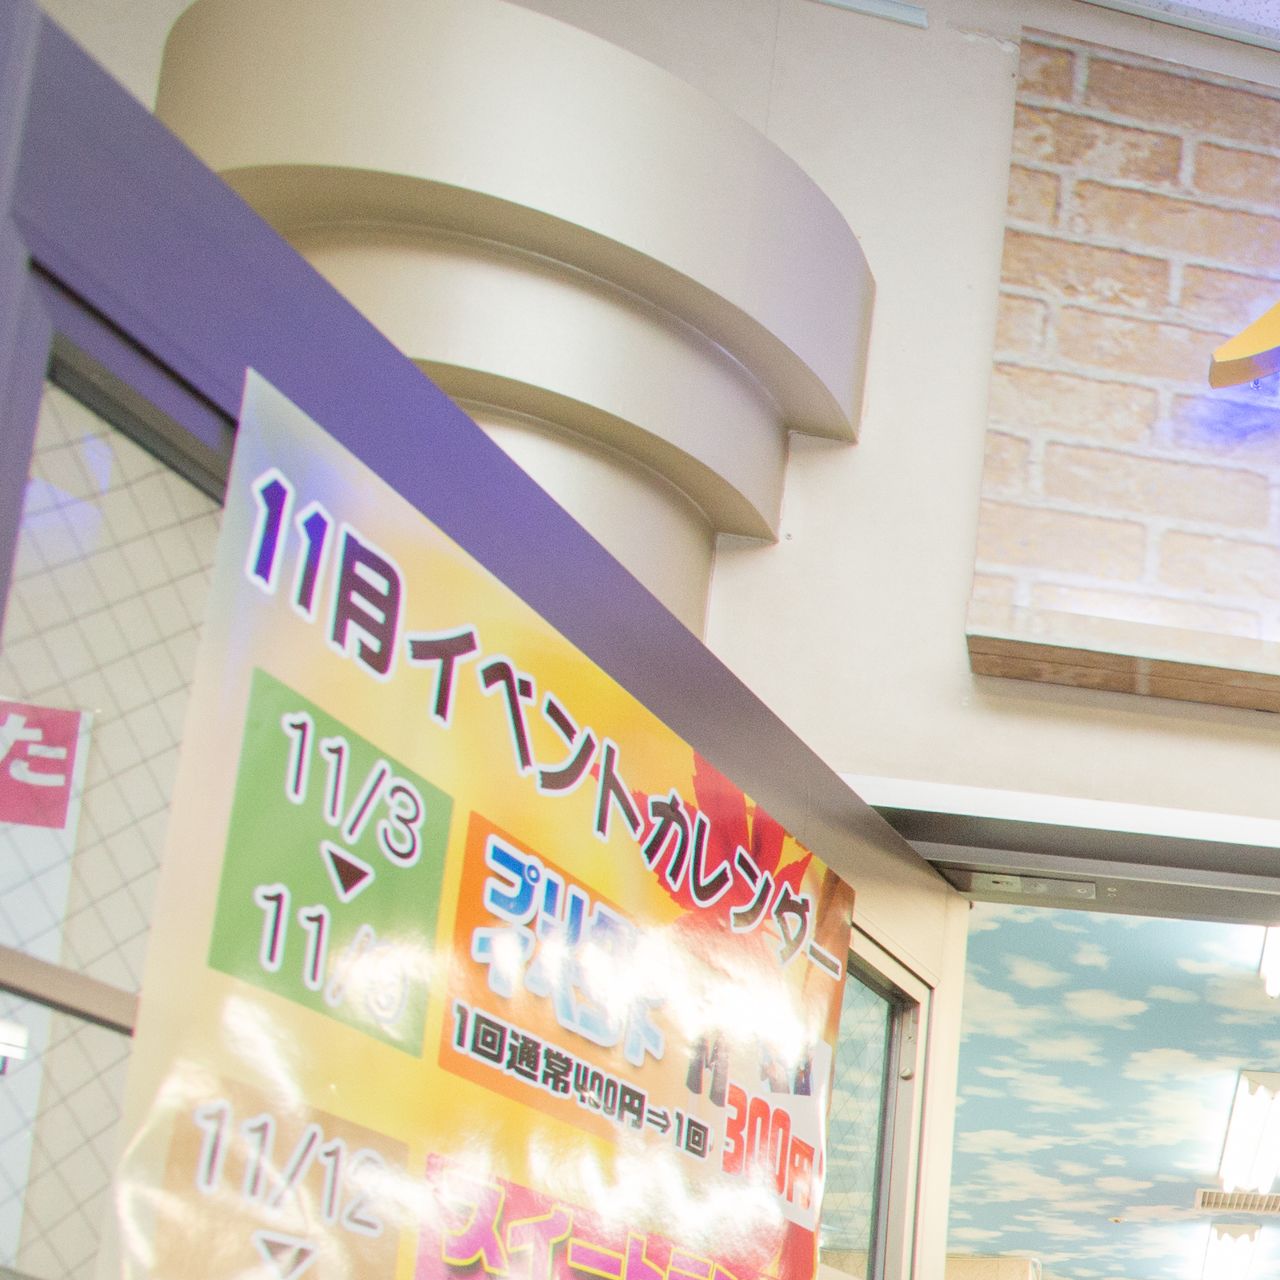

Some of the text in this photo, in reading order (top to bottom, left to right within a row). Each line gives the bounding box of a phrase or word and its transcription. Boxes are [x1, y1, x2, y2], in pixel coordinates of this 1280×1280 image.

[250, 468, 842, 980] 11月イベントカレンダー
[282, 710, 424, 868] 11/3
[254, 882, 410, 1026] 11/
[721, 1080, 817, 1212] 300円
